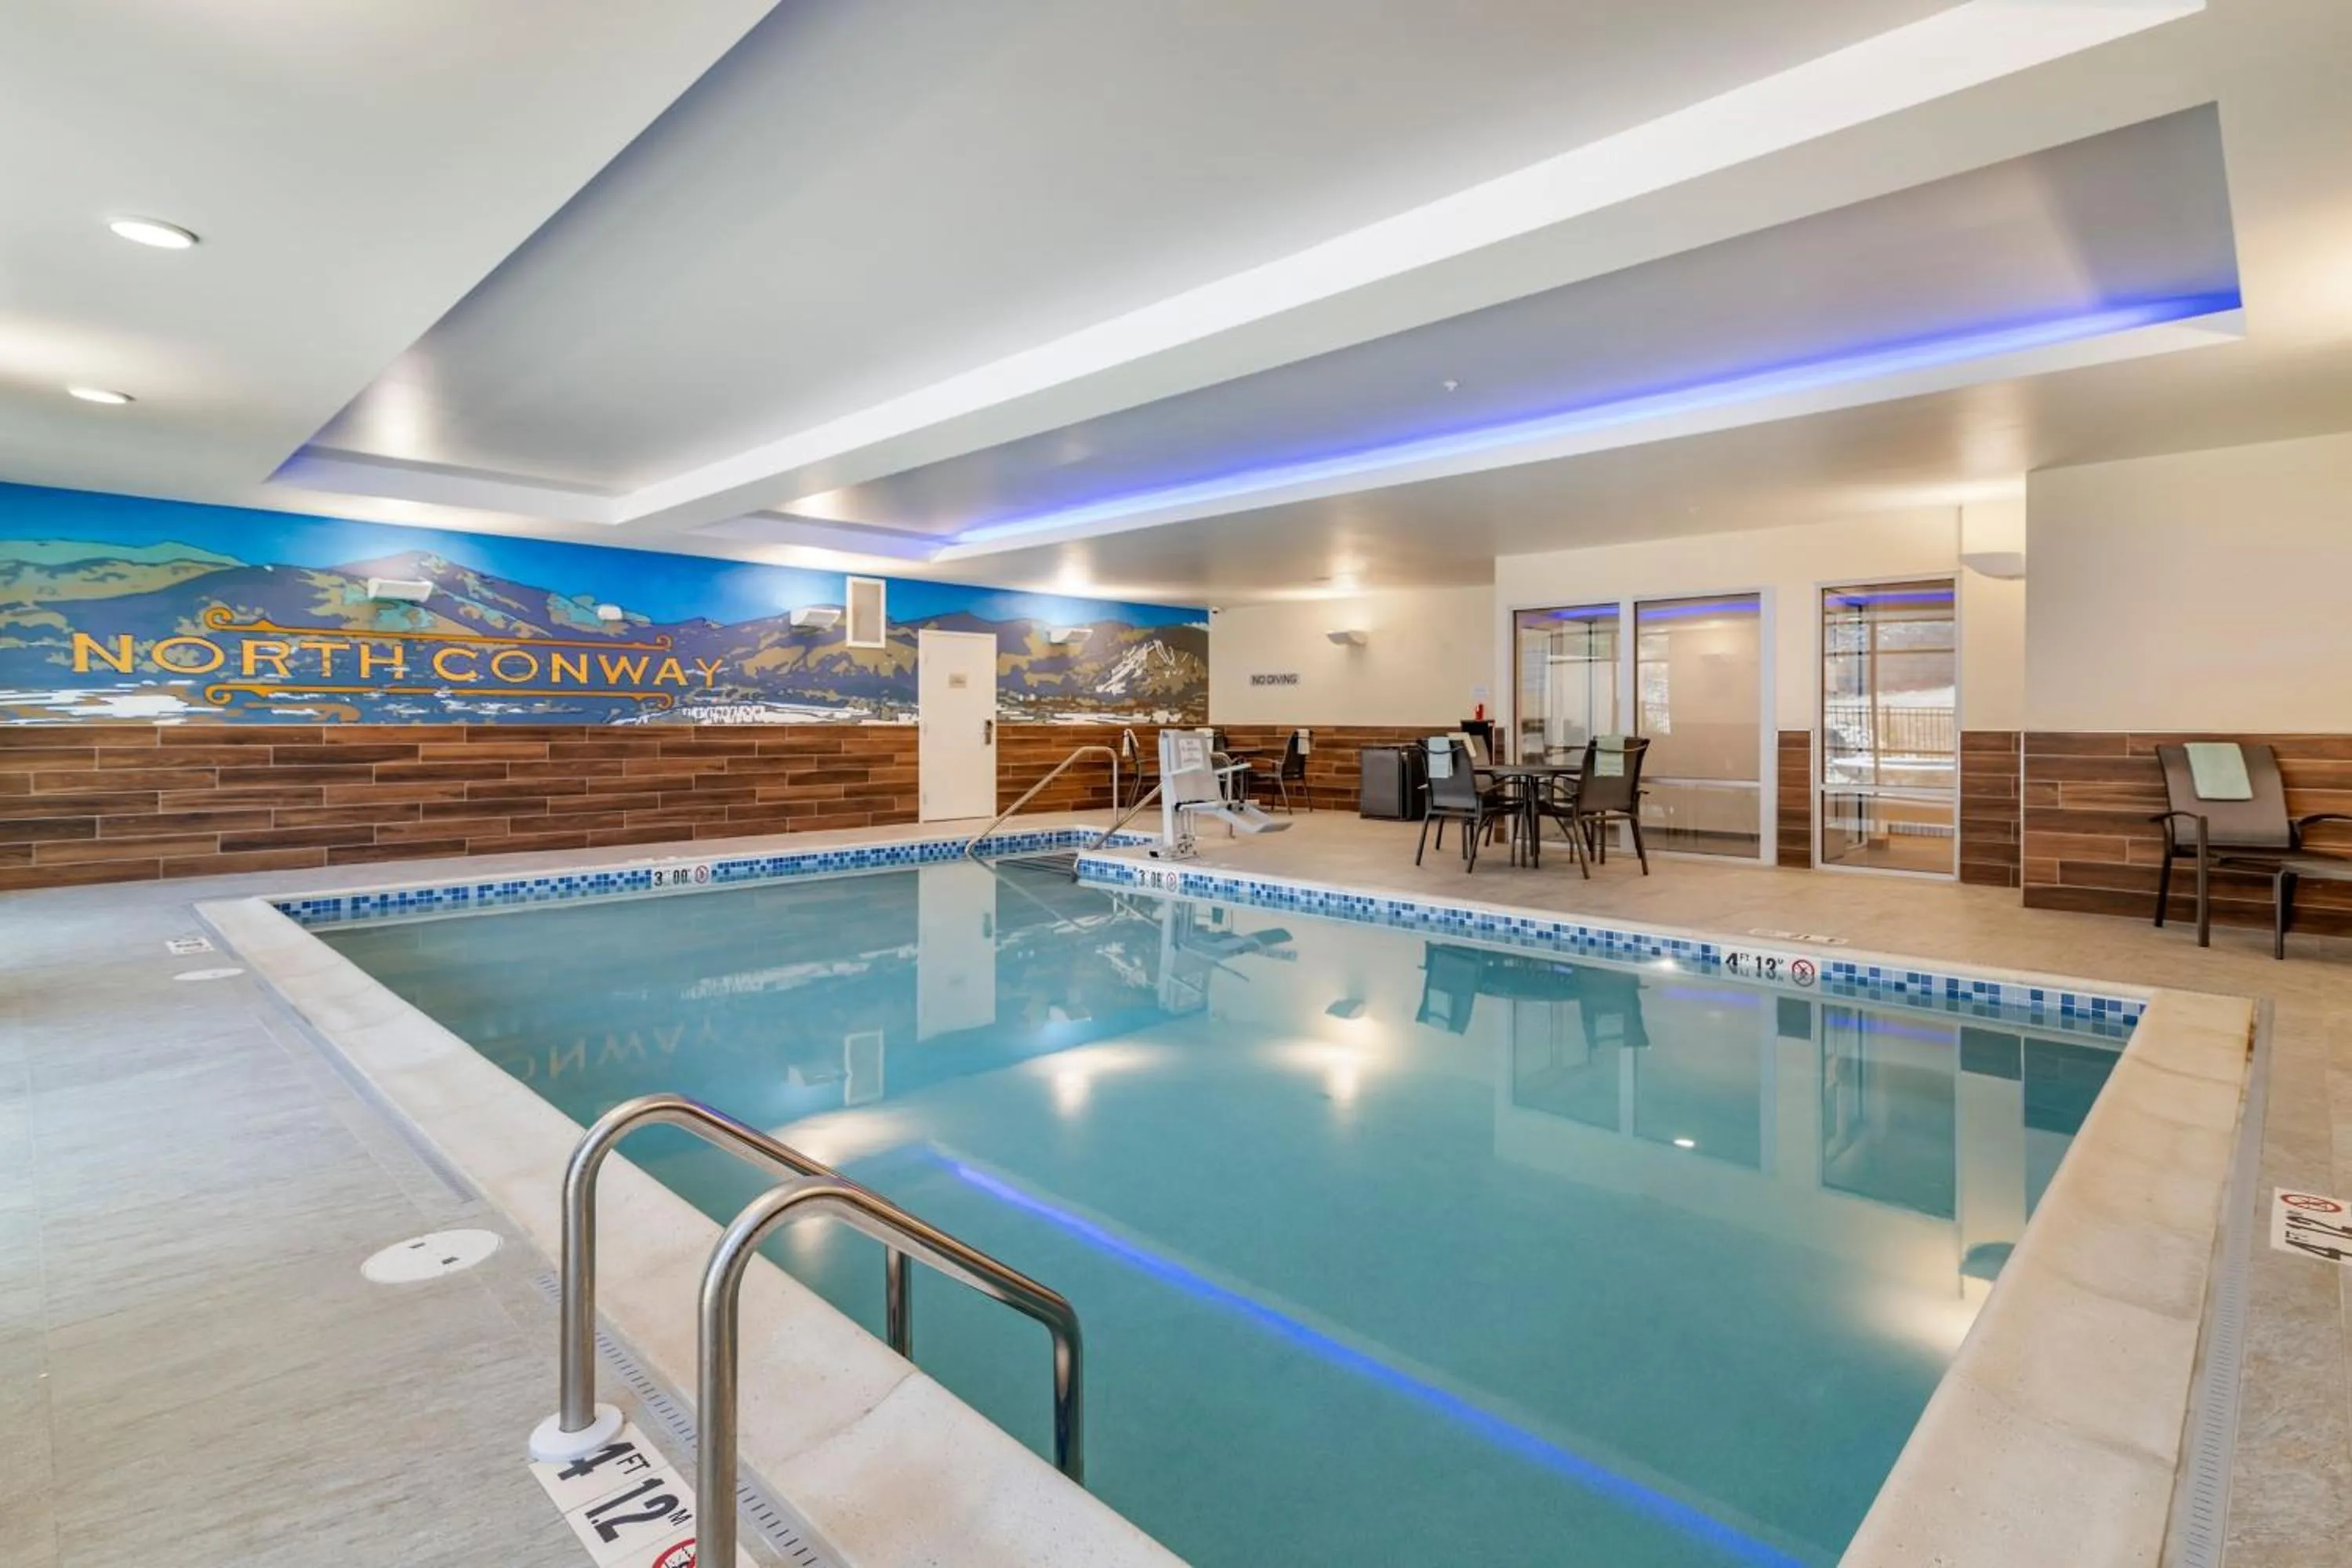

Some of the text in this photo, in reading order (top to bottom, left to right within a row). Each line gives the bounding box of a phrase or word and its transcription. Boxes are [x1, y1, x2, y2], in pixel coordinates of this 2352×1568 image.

[72, 632, 724, 687] NORTH CONWAY
[1251, 674, 1266, 685] NO
[557, 1442, 636, 1481] 4
[615, 1453, 652, 1475] FT
[667, 1508, 693, 1526] M
